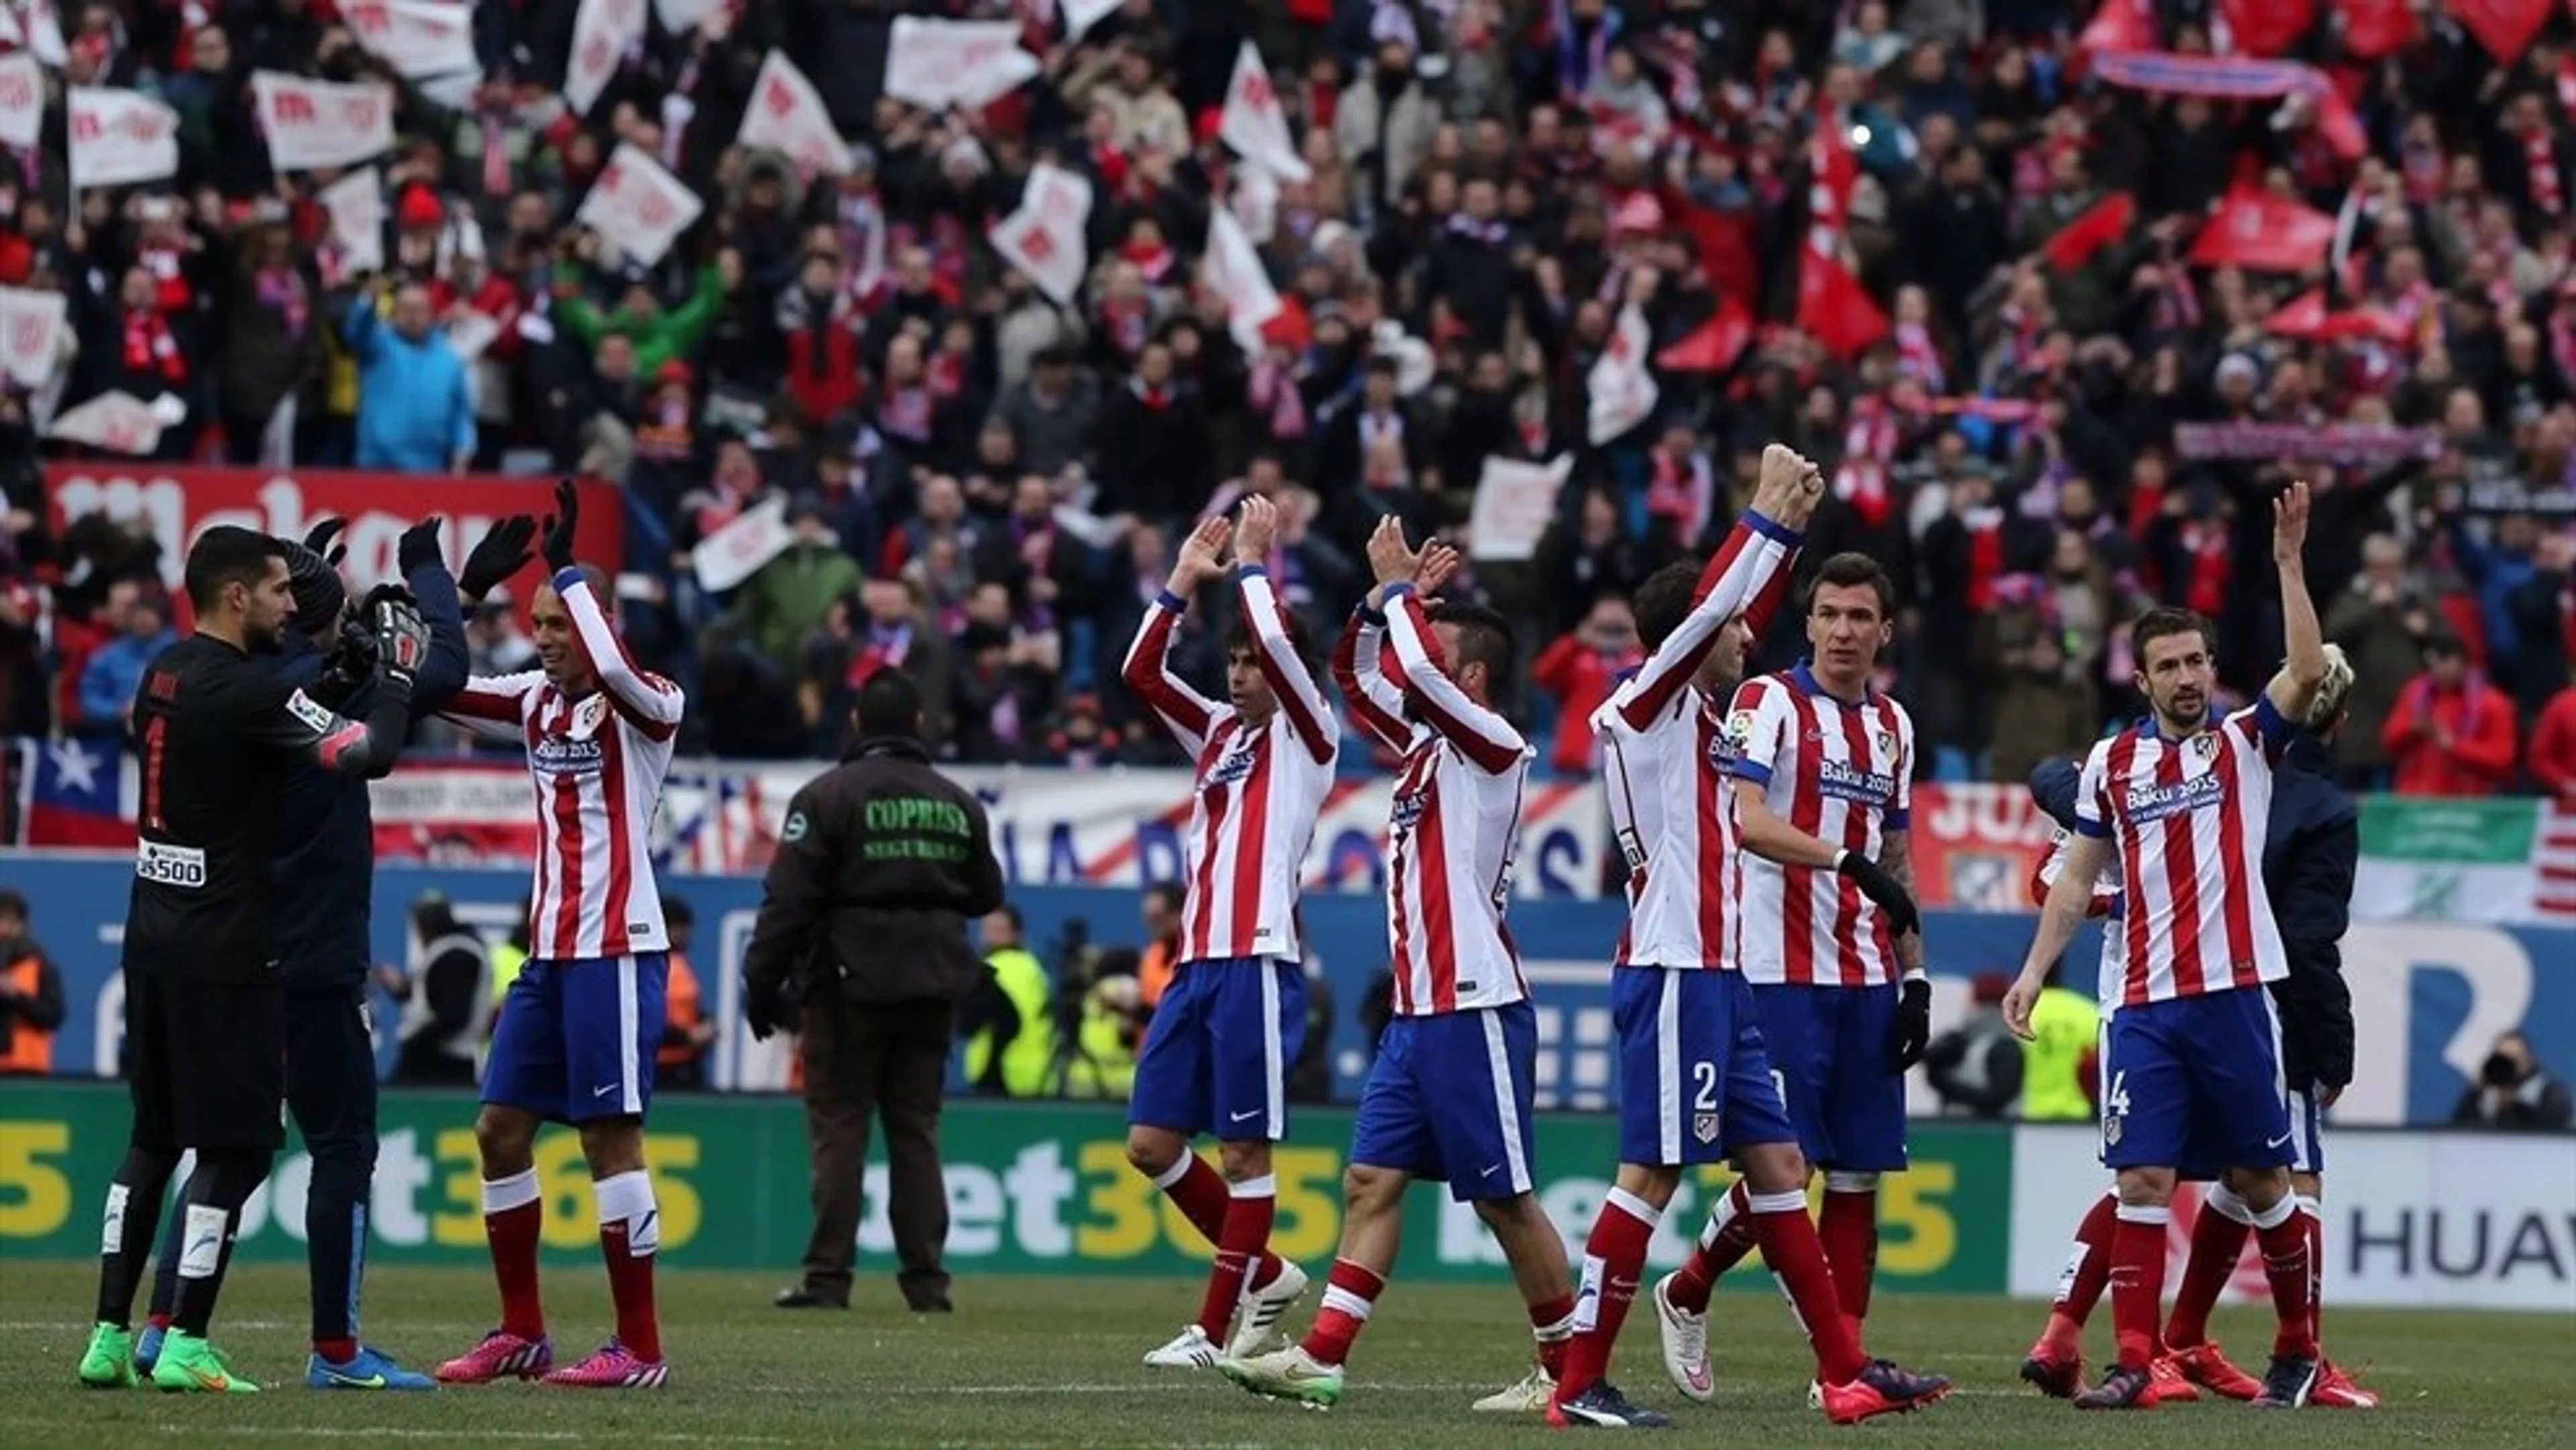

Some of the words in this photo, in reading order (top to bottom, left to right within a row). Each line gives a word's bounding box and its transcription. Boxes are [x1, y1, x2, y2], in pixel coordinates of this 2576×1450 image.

[2127, 781, 2173, 811] Baku
[2176, 774, 2220, 802] 2015
[865, 796, 972, 838] COPRISE
[1693, 1060, 1717, 1110] 2
[2350, 1206, 2576, 1280] HUA
